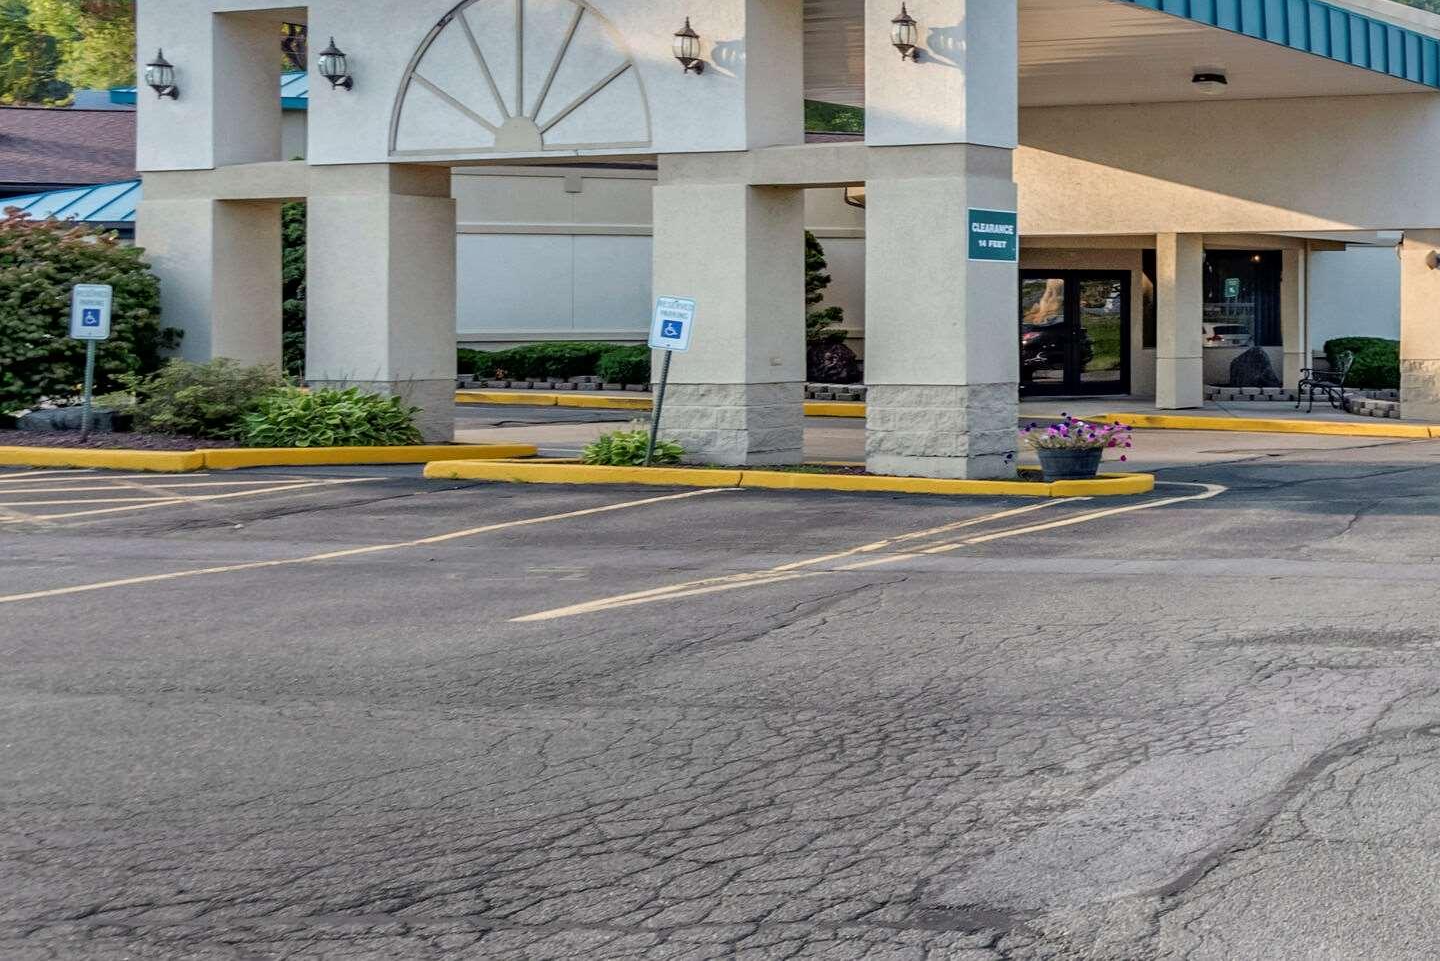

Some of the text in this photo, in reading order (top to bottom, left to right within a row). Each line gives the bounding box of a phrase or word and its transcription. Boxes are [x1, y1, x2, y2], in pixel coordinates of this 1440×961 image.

[971, 222, 1014, 235] CLEARANCE
[978, 239, 1007, 248] 14 FEET
